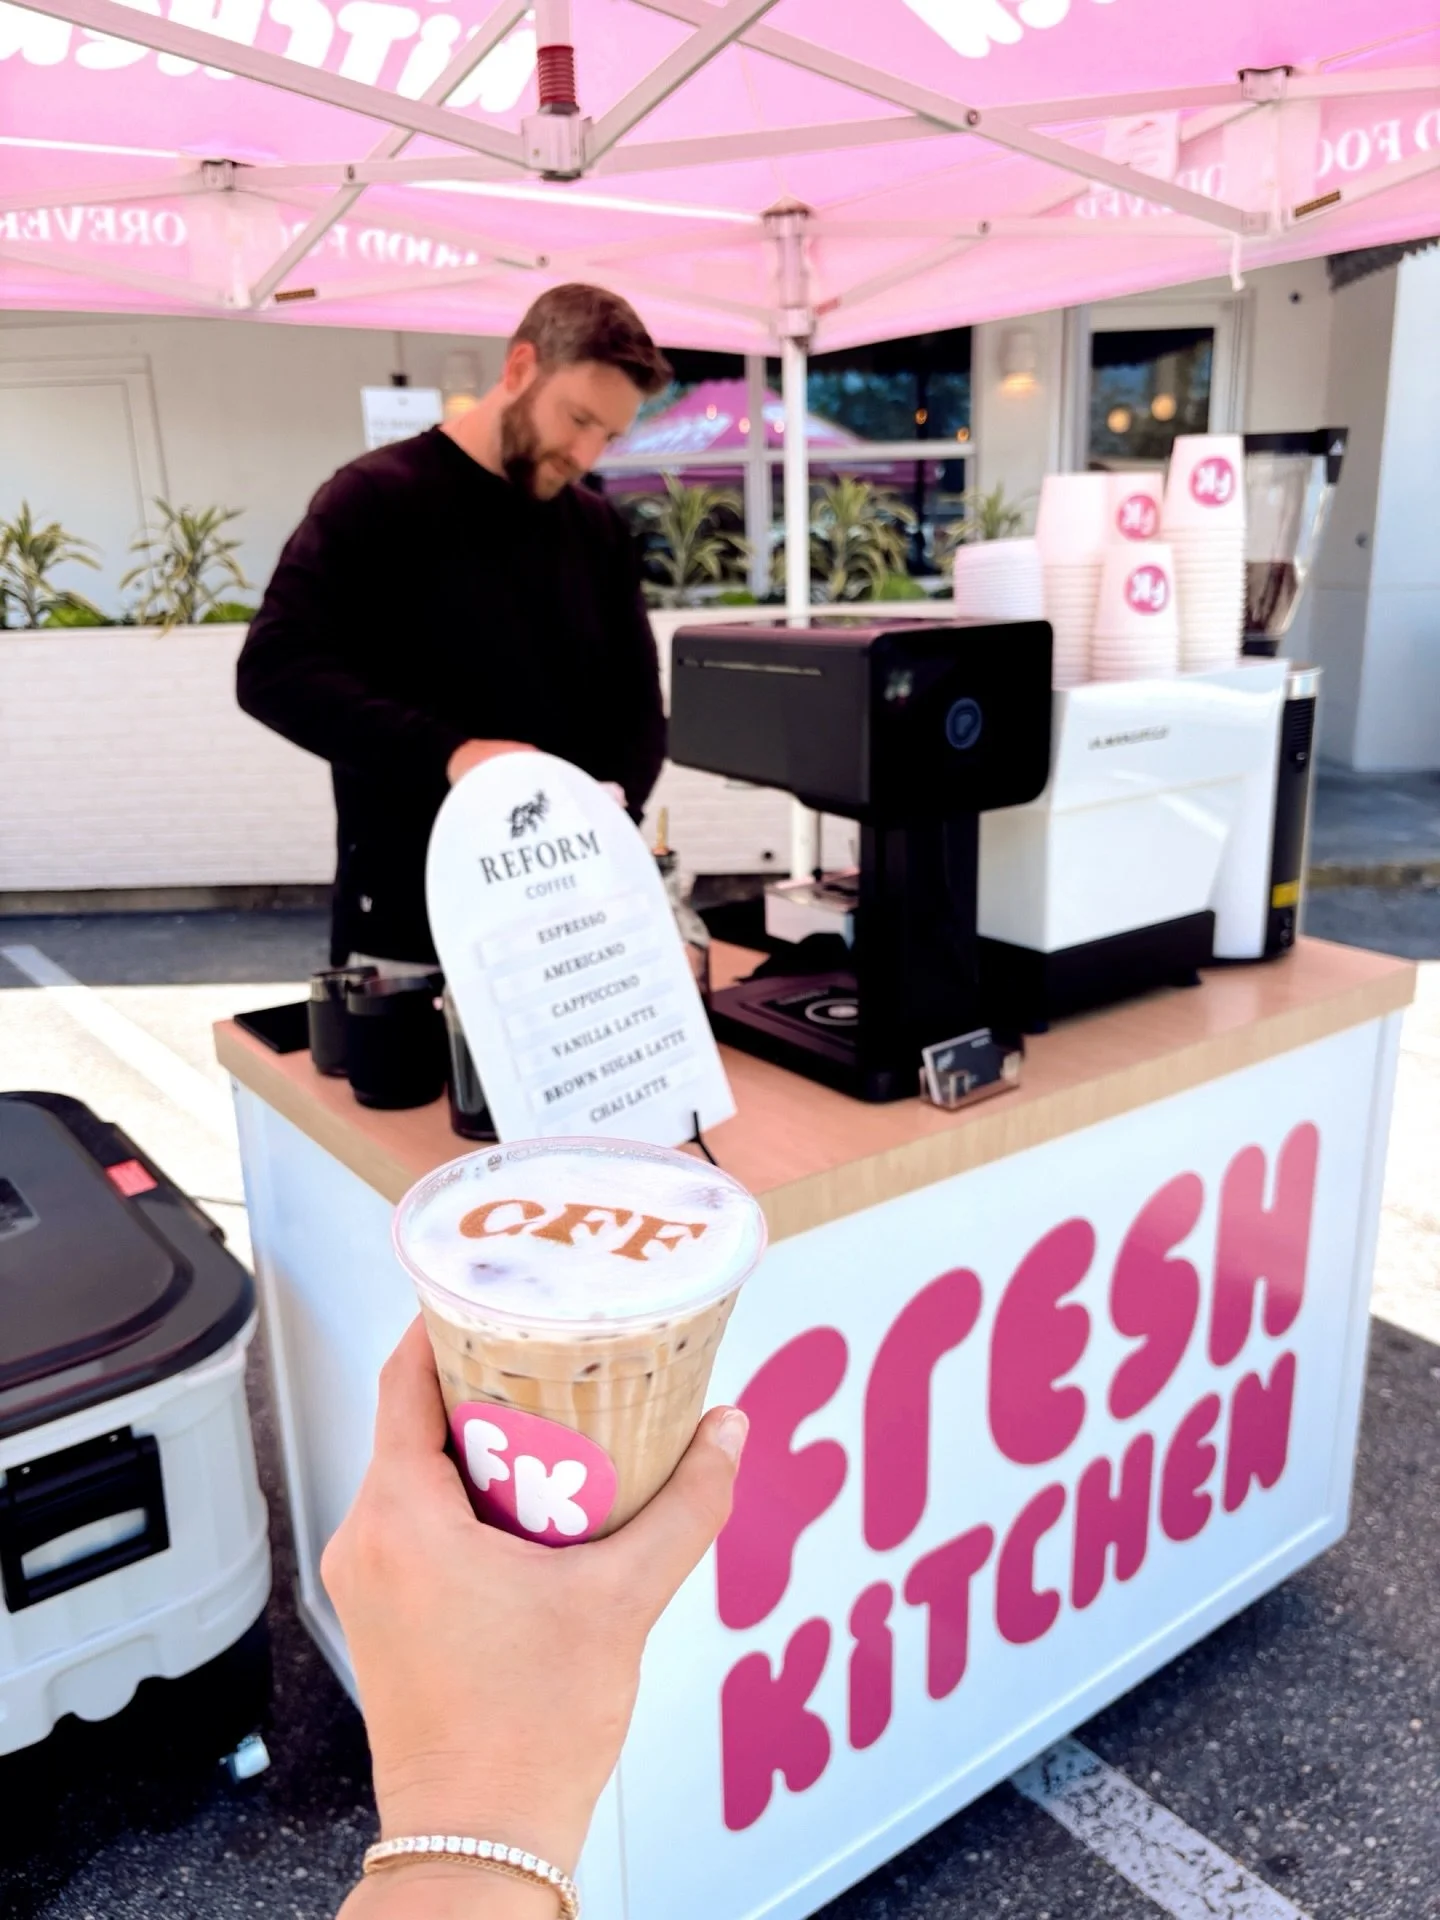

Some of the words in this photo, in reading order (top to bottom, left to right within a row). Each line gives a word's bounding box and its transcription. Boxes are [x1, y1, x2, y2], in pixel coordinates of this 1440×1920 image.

[479, 829, 600, 885] REFORM
[525, 874, 577, 900] COFFEE
[537, 910, 607, 944] ESPRESSO
[543, 942, 626, 982] AMERICANO
[551, 974, 640, 1018] CAPPUCCINO
[551, 1023, 614, 1058] VANILLA
[614, 1005, 658, 1033] LATTE
[543, 1067, 599, 1105] BROWN
[599, 1047, 645, 1078] SUGAR
[644, 1028, 687, 1057] LATTE
[589, 1095, 626, 1124] CHAI
[625, 1075, 670, 1107] LATTE
[463, 1418, 589, 1537] FK
[720, 1350, 1297, 1832] KITCHEN
